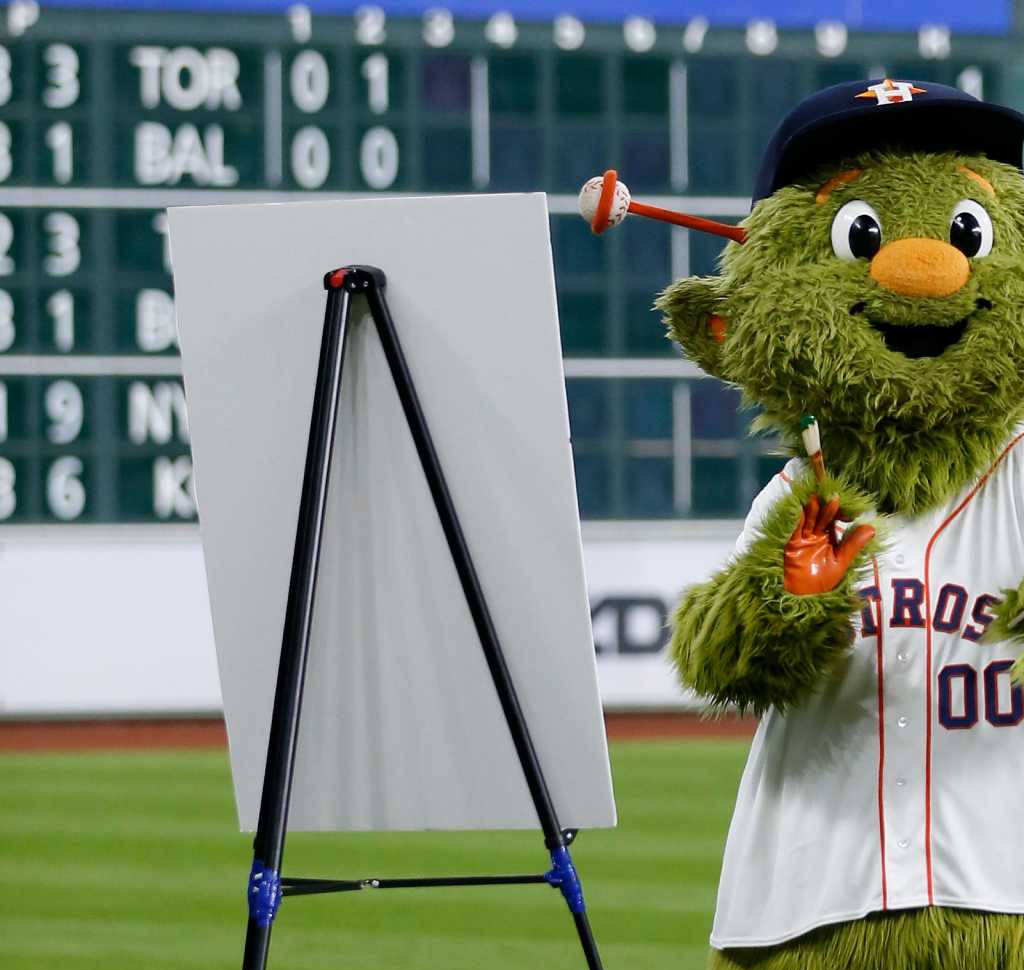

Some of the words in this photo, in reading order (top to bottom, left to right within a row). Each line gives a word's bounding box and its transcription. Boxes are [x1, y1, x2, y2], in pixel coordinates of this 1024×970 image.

[44, 43, 80, 109] 3
[129, 46, 242, 110] TOR
[290, 50, 329, 114] 0
[361, 53, 389, 115] 1
[46, 121, 73, 185] 1
[134, 120, 239, 187] BAL
[291, 126, 330, 189] 0
[360, 126, 399, 190] 0
[44, 211, 80, 277] 3
[47, 290, 74, 353] 1
[44, 380, 83, 444] 9
[46, 455, 86, 521] 6
